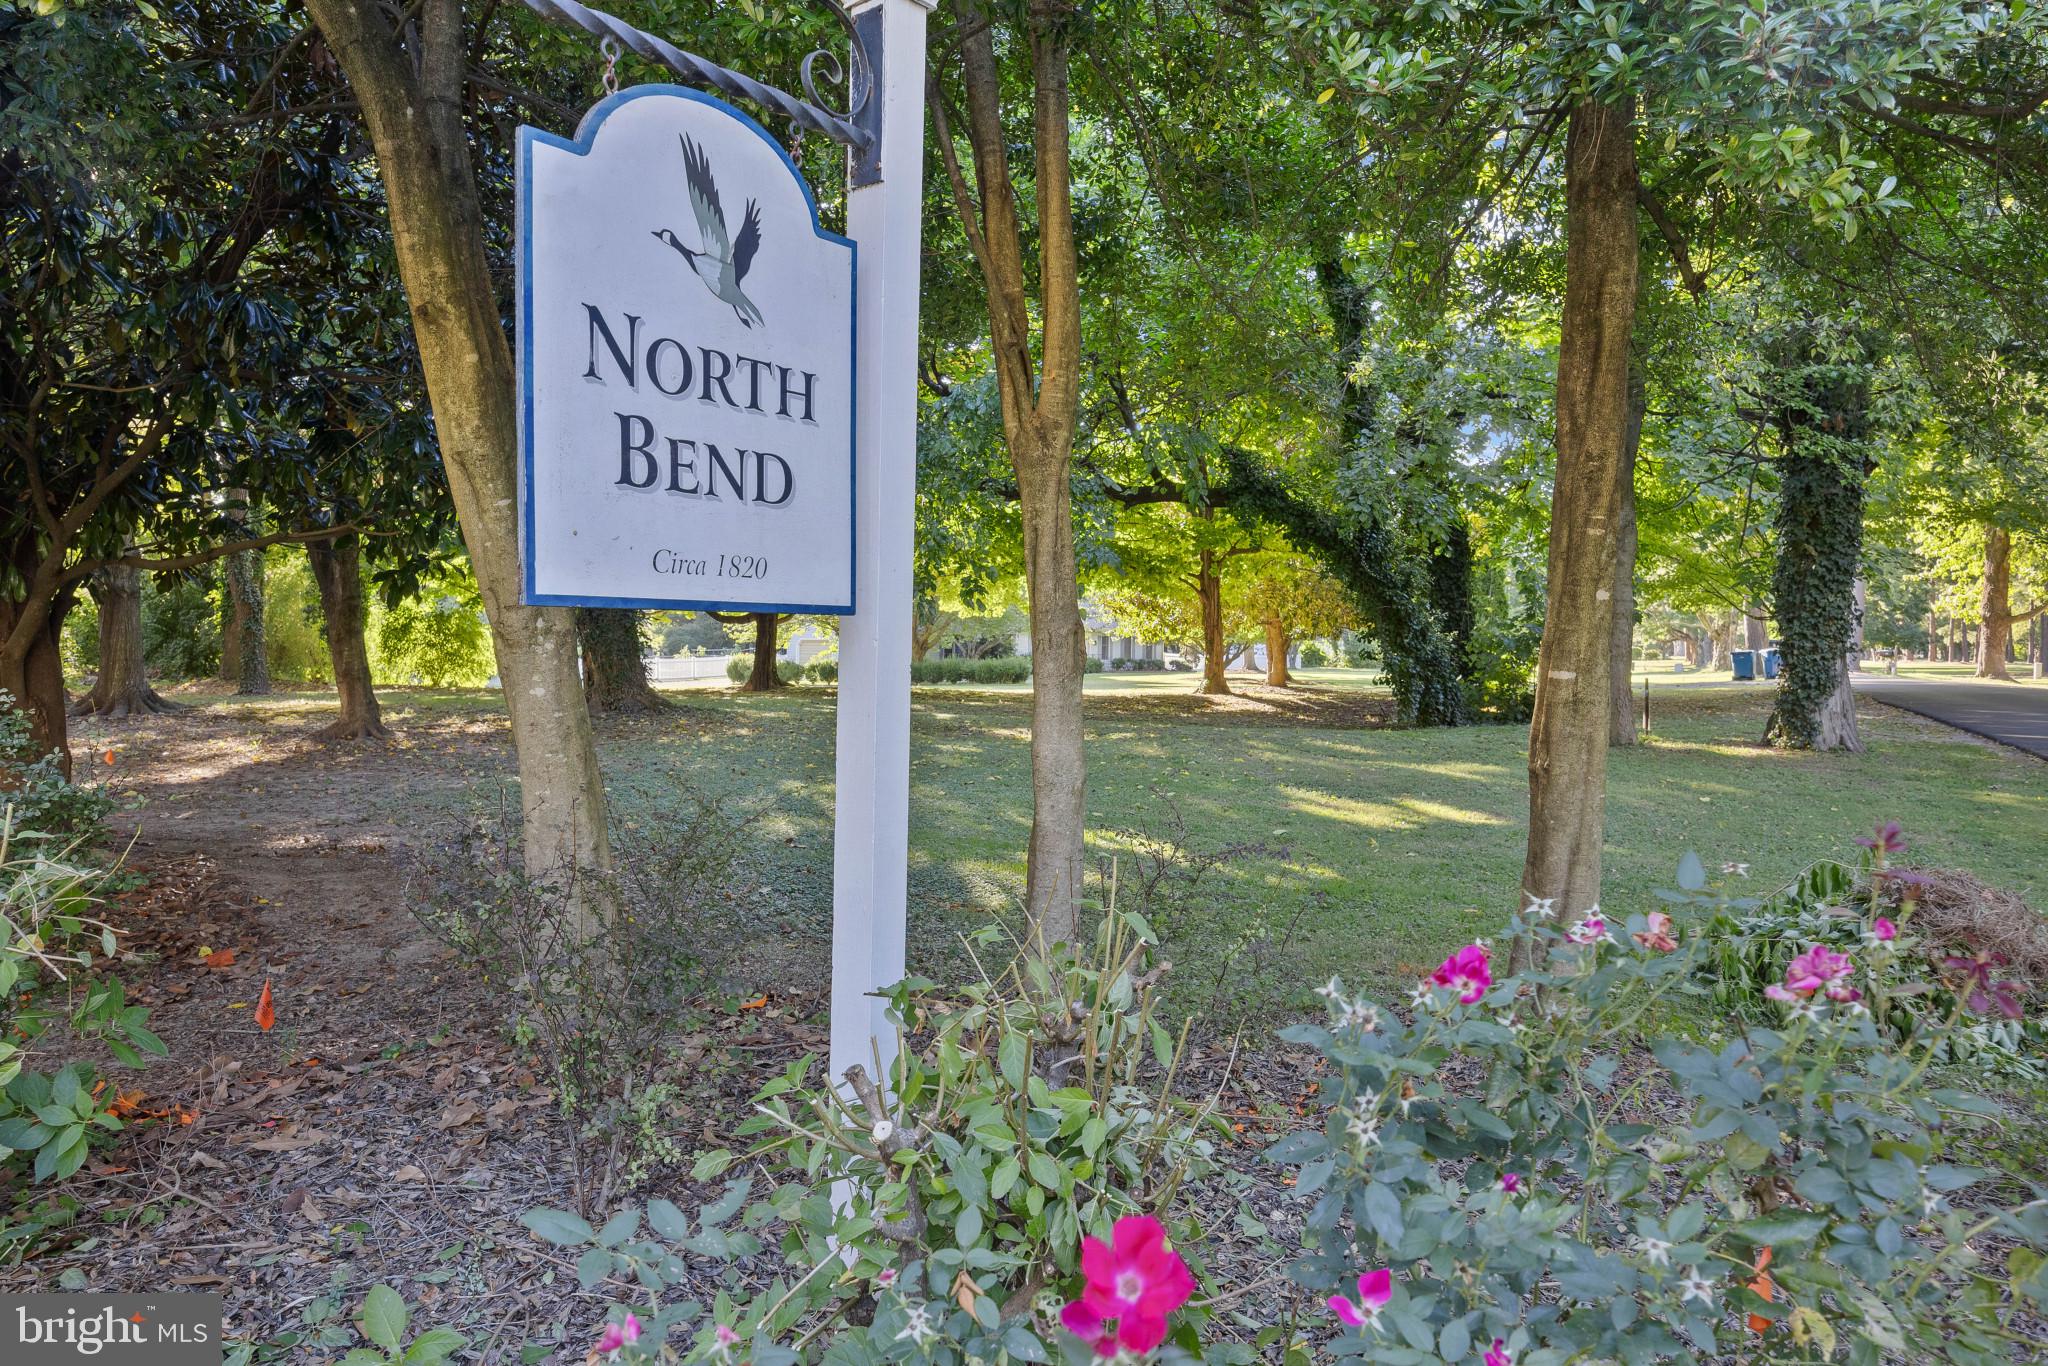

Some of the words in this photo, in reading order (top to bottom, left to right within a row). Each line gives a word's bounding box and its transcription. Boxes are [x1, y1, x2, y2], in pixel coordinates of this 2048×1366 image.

[582, 302, 818, 424] NORTH
[613, 411, 796, 508] BEND
[652, 548, 707, 577] Circa
[717, 554, 768, 580] 1820
